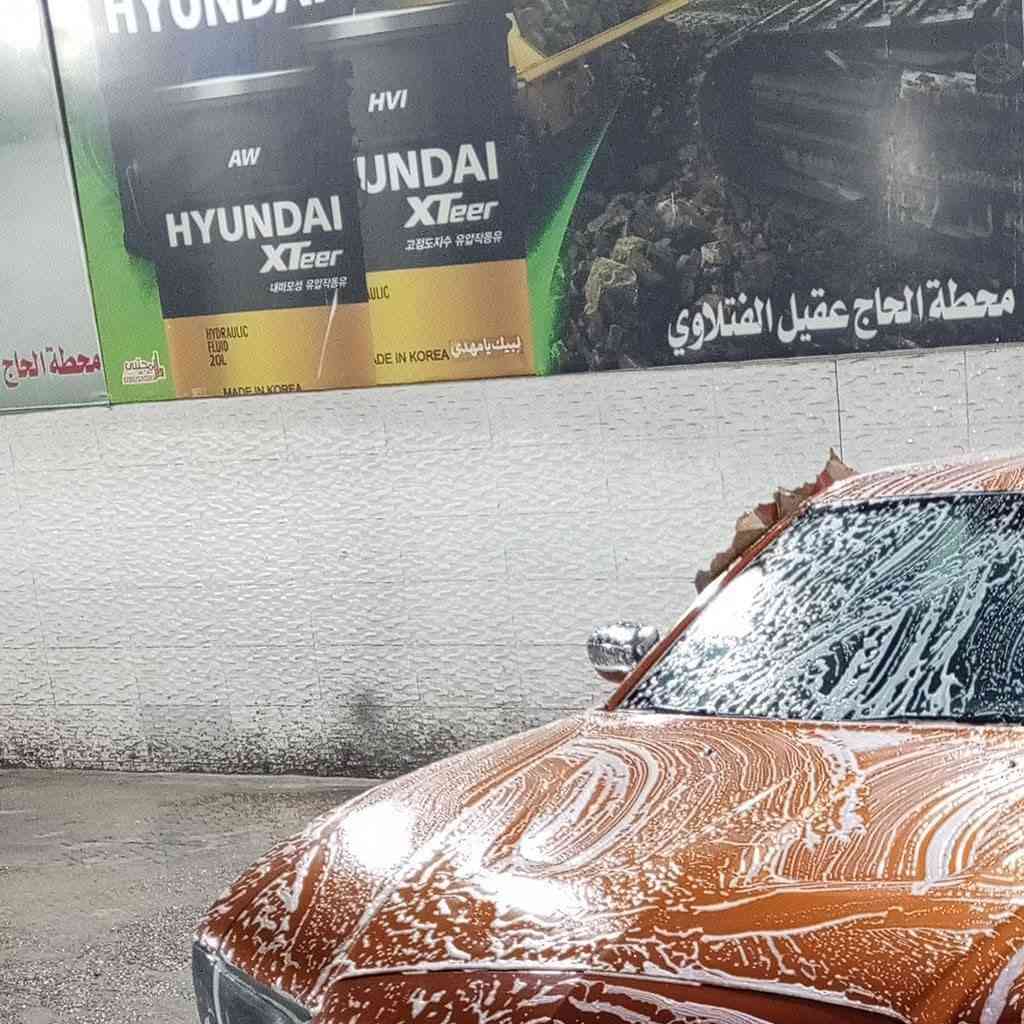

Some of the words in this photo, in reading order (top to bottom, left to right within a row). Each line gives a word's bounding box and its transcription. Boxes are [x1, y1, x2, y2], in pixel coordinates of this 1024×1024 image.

[104, 0, 326, 33] HYUN
[367, 88, 409, 113] HVI
[228, 147, 260, 169] AW
[354, 141, 499, 194] UNDAI
[165, 195, 343, 247] HYUNDAI
[854, 286, 925, 340] الحاج
[927, 278, 1016, 319] محطة
[205, 325, 249, 340] HYDRAULIC
[667, 291, 773, 354] الفتلاوي
[777, 289, 851, 343] عقيل
[46, 344, 101, 375] محطة
[207, 340, 229, 354] FLUID
[208, 354, 228, 367] 20L
[374, 352, 393, 365] DE
[395, 352, 407, 364] IN
[409, 349, 450, 363] KOREA
[2, 349, 47, 389] الحاج
